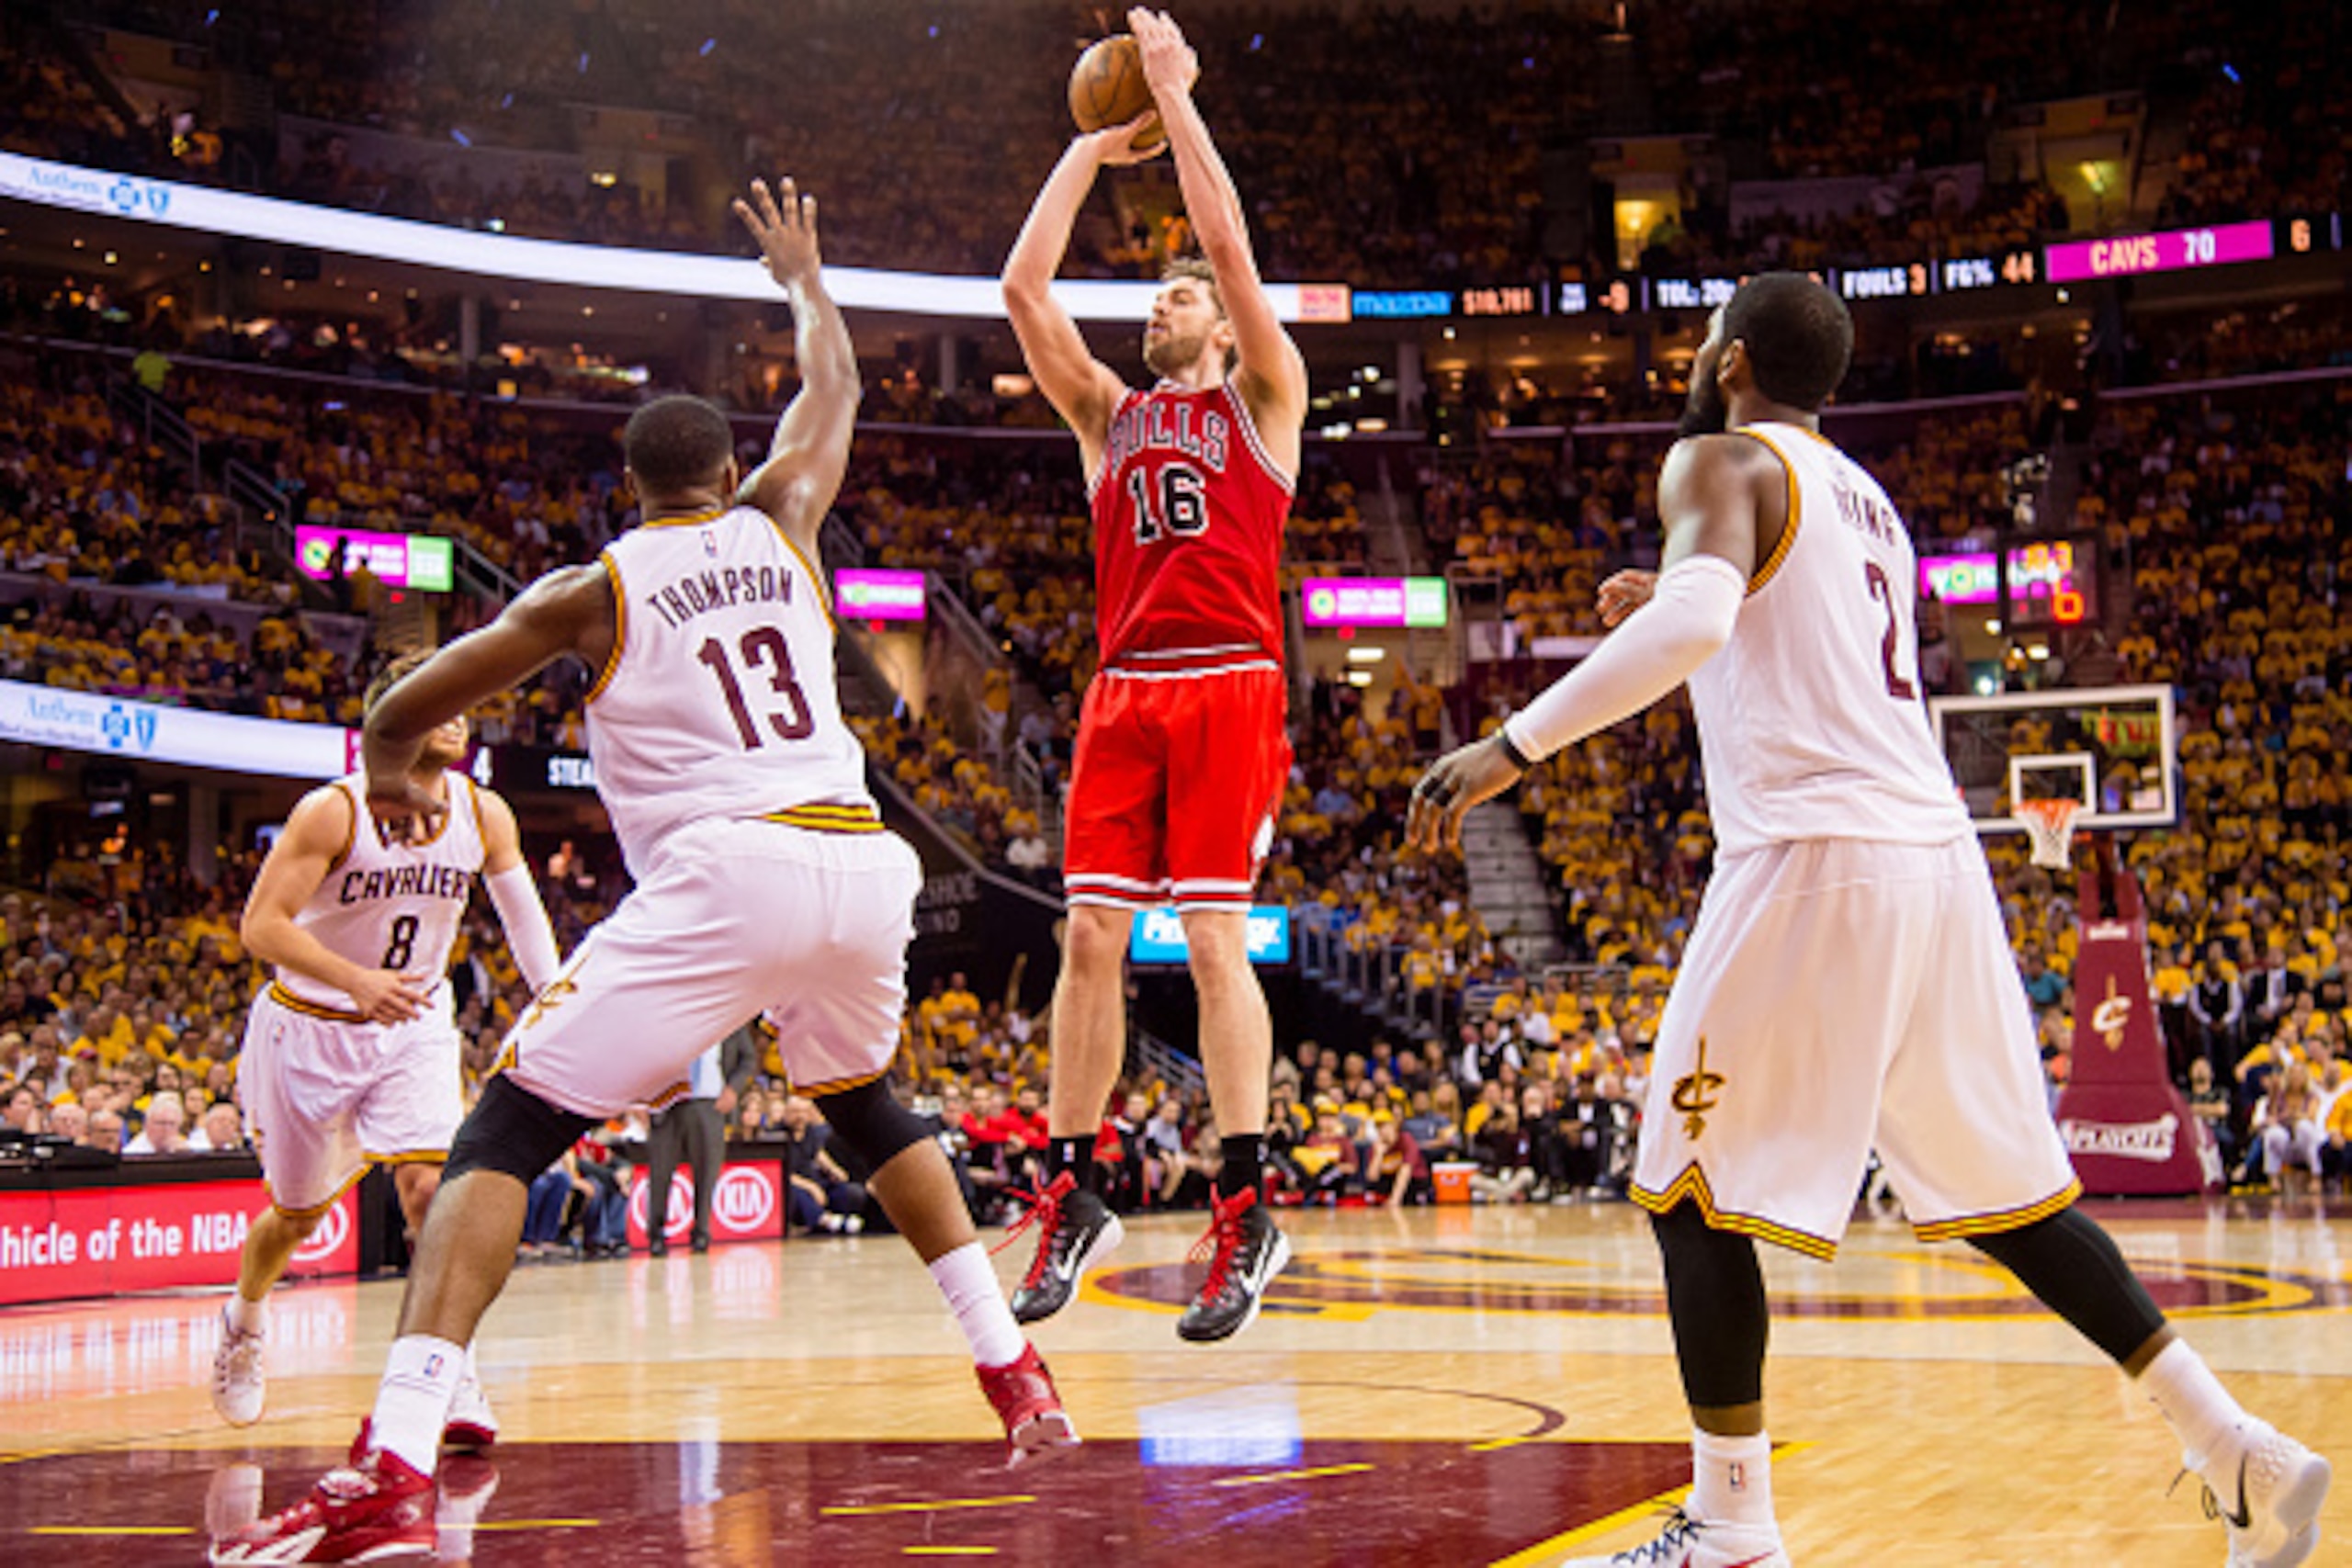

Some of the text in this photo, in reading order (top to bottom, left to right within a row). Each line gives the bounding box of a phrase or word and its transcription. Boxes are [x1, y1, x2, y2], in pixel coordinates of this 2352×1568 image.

[2001, 252, 2034, 284] 44
[2089, 229, 2215, 275] CAVS 70
[1842, 266, 1906, 299] FOULS
[1109, 401, 1228, 479] BULLS
[1127, 462, 1209, 547] 16
[647, 566, 792, 629] THOMPSON
[1864, 558, 1916, 701] 2
[697, 626, 815, 751] 13
[381, 915, 420, 970] 8
[2075, 1124, 2174, 1150] PLAYOFFS
[724, 1181, 762, 1217] KIA
[86, 1219, 120, 1260] of
[130, 1218, 183, 1258] the
[192, 1213, 250, 1253] NBA
